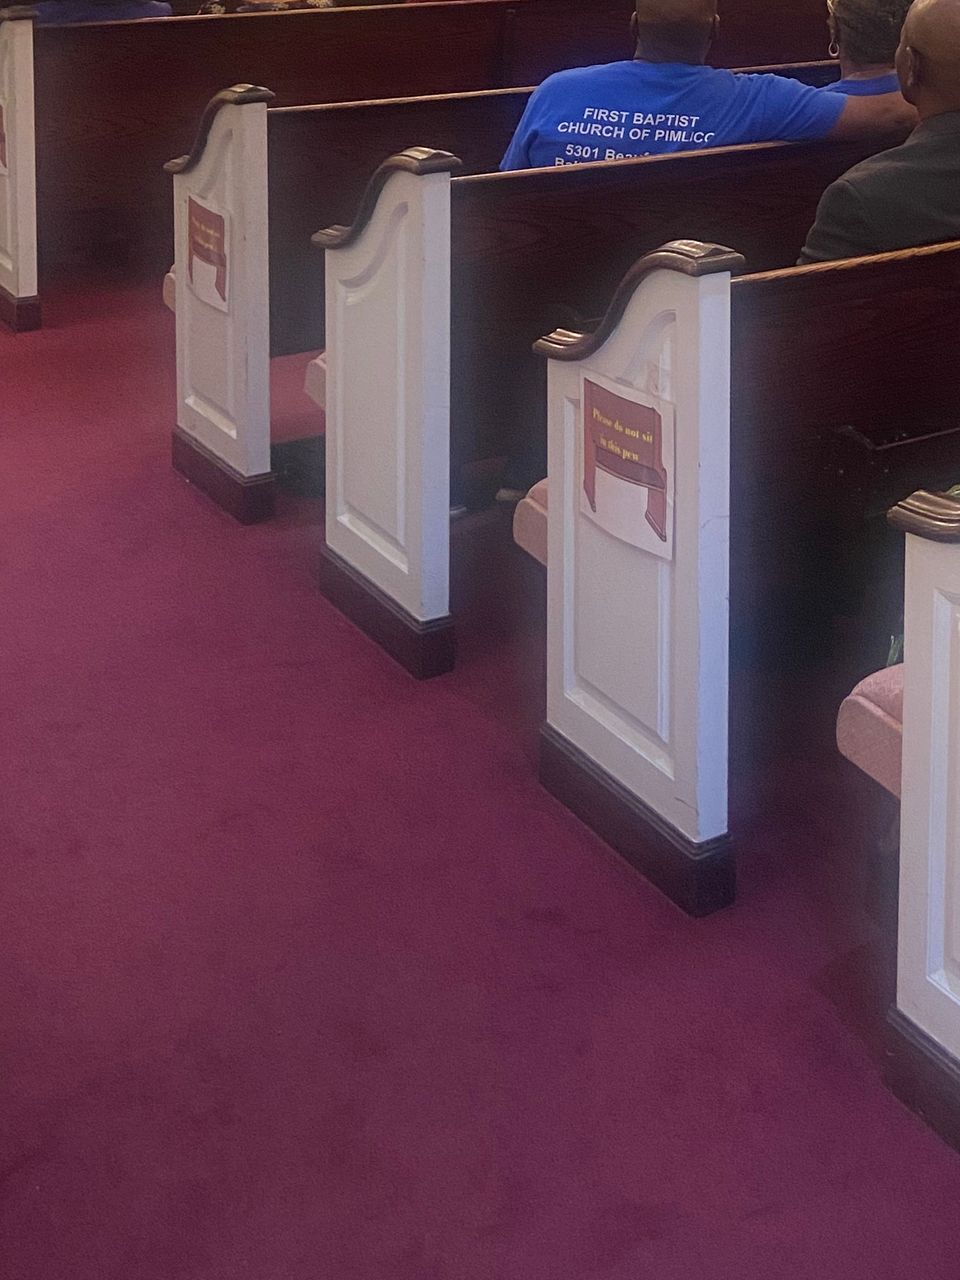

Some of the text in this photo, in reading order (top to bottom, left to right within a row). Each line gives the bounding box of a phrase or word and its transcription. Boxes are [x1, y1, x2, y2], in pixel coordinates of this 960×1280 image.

[583, 107, 700, 128] FIRST BAPTIST
[557, 121, 625, 140] CHURCH
[628, 127, 651, 141] OF
[565, 144, 599, 159] 5301
[614, 418, 624, 433] do
[625, 426, 640, 439] not
[642, 431, 653, 445] sit
